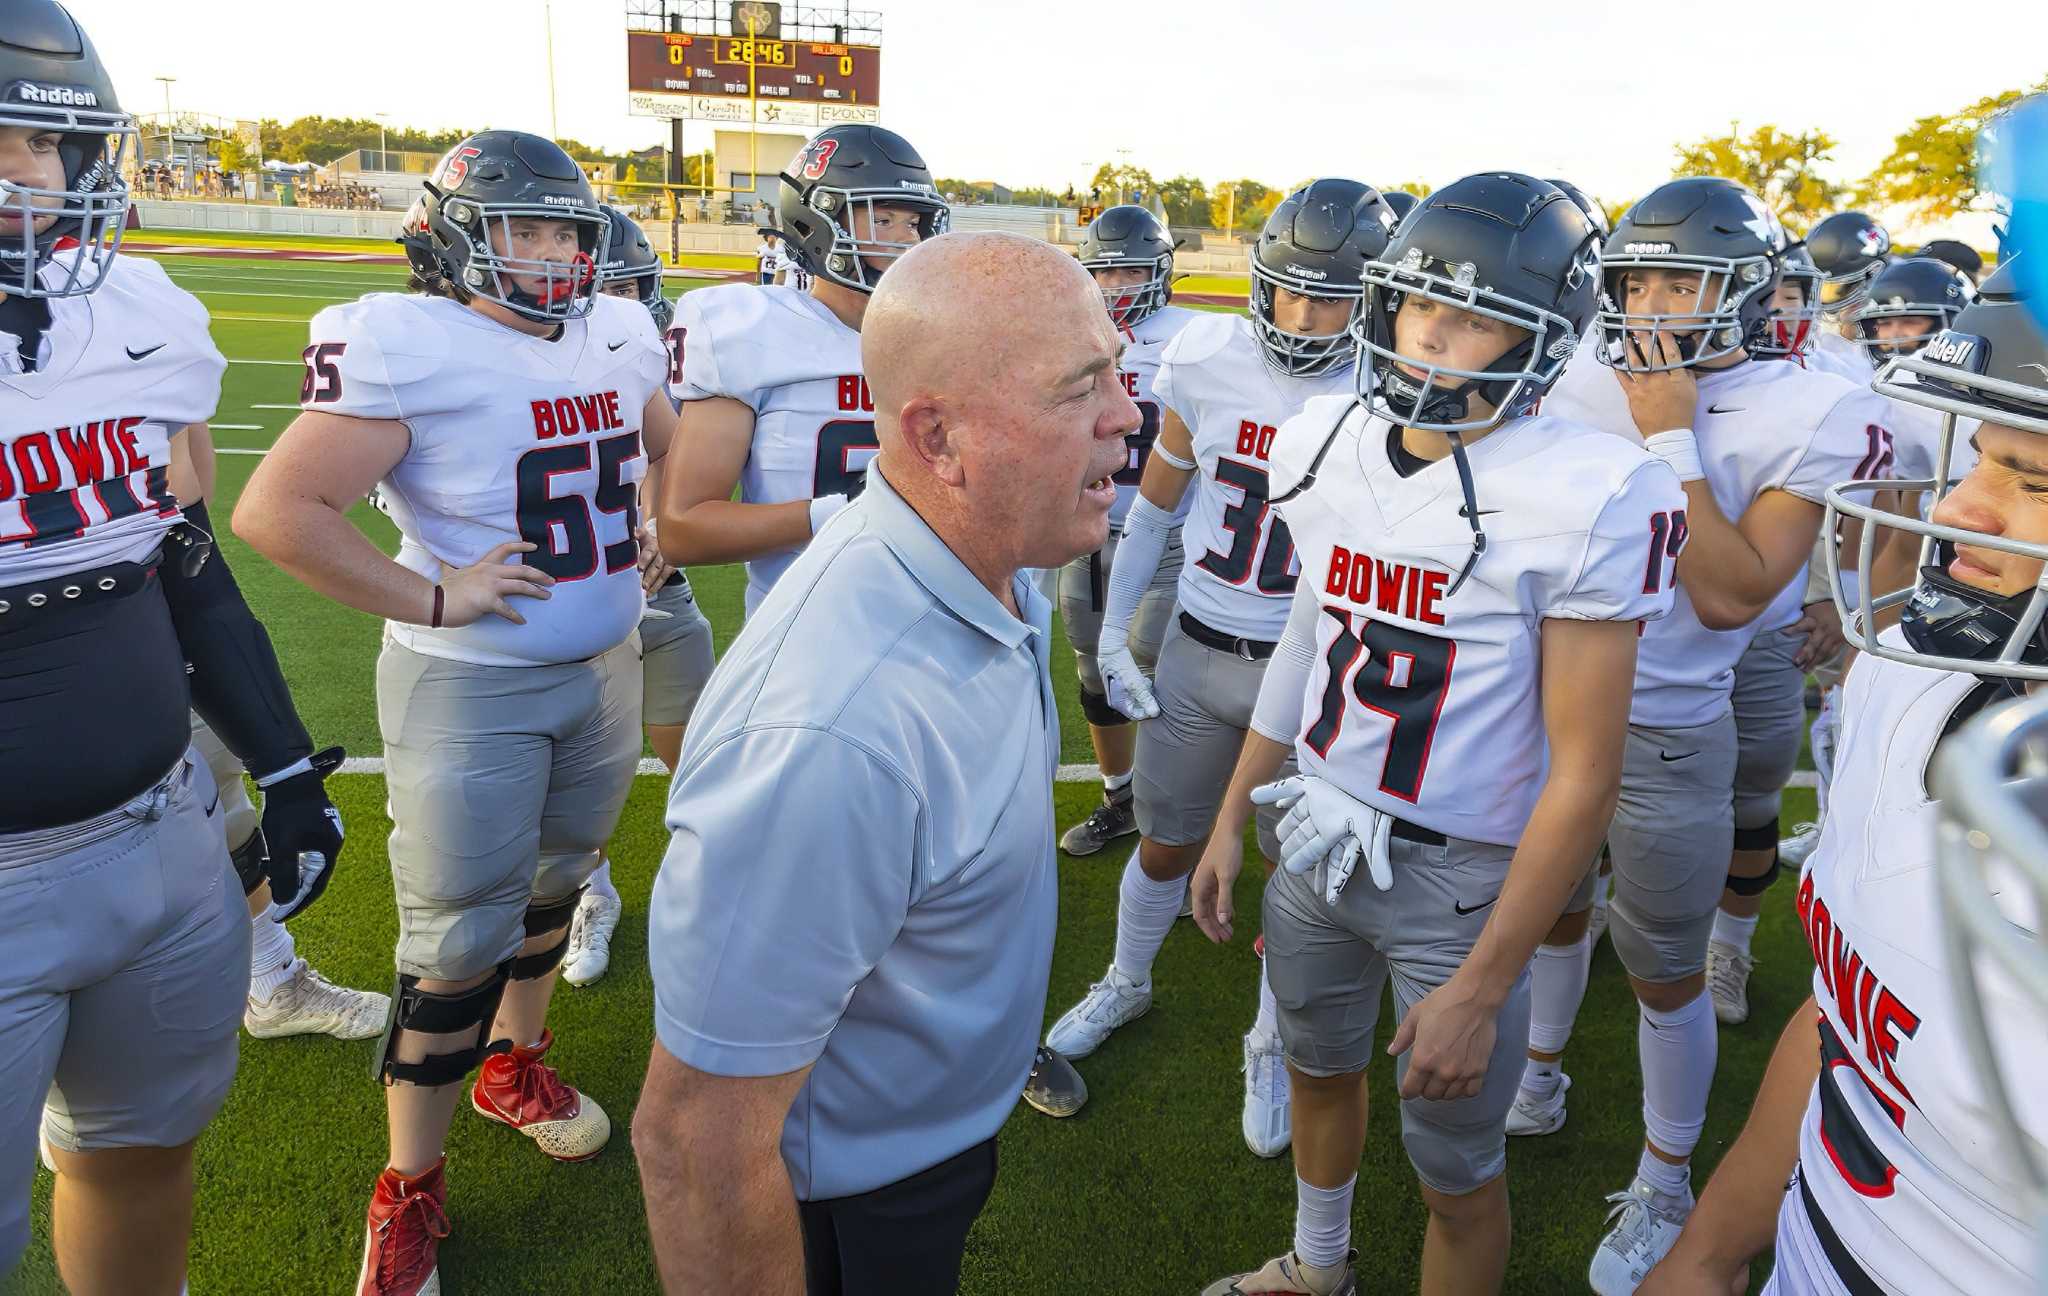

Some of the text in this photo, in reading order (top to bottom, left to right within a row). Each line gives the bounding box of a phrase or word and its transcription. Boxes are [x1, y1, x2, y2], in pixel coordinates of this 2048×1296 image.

[670, 45, 684, 65] 0
[839, 56, 853, 76] 0
[531, 391, 625, 440] BOWIE
[515, 431, 641, 583] 65
[1325, 543, 1451, 626] BOWIE
[1305, 605, 1457, 806] 19
